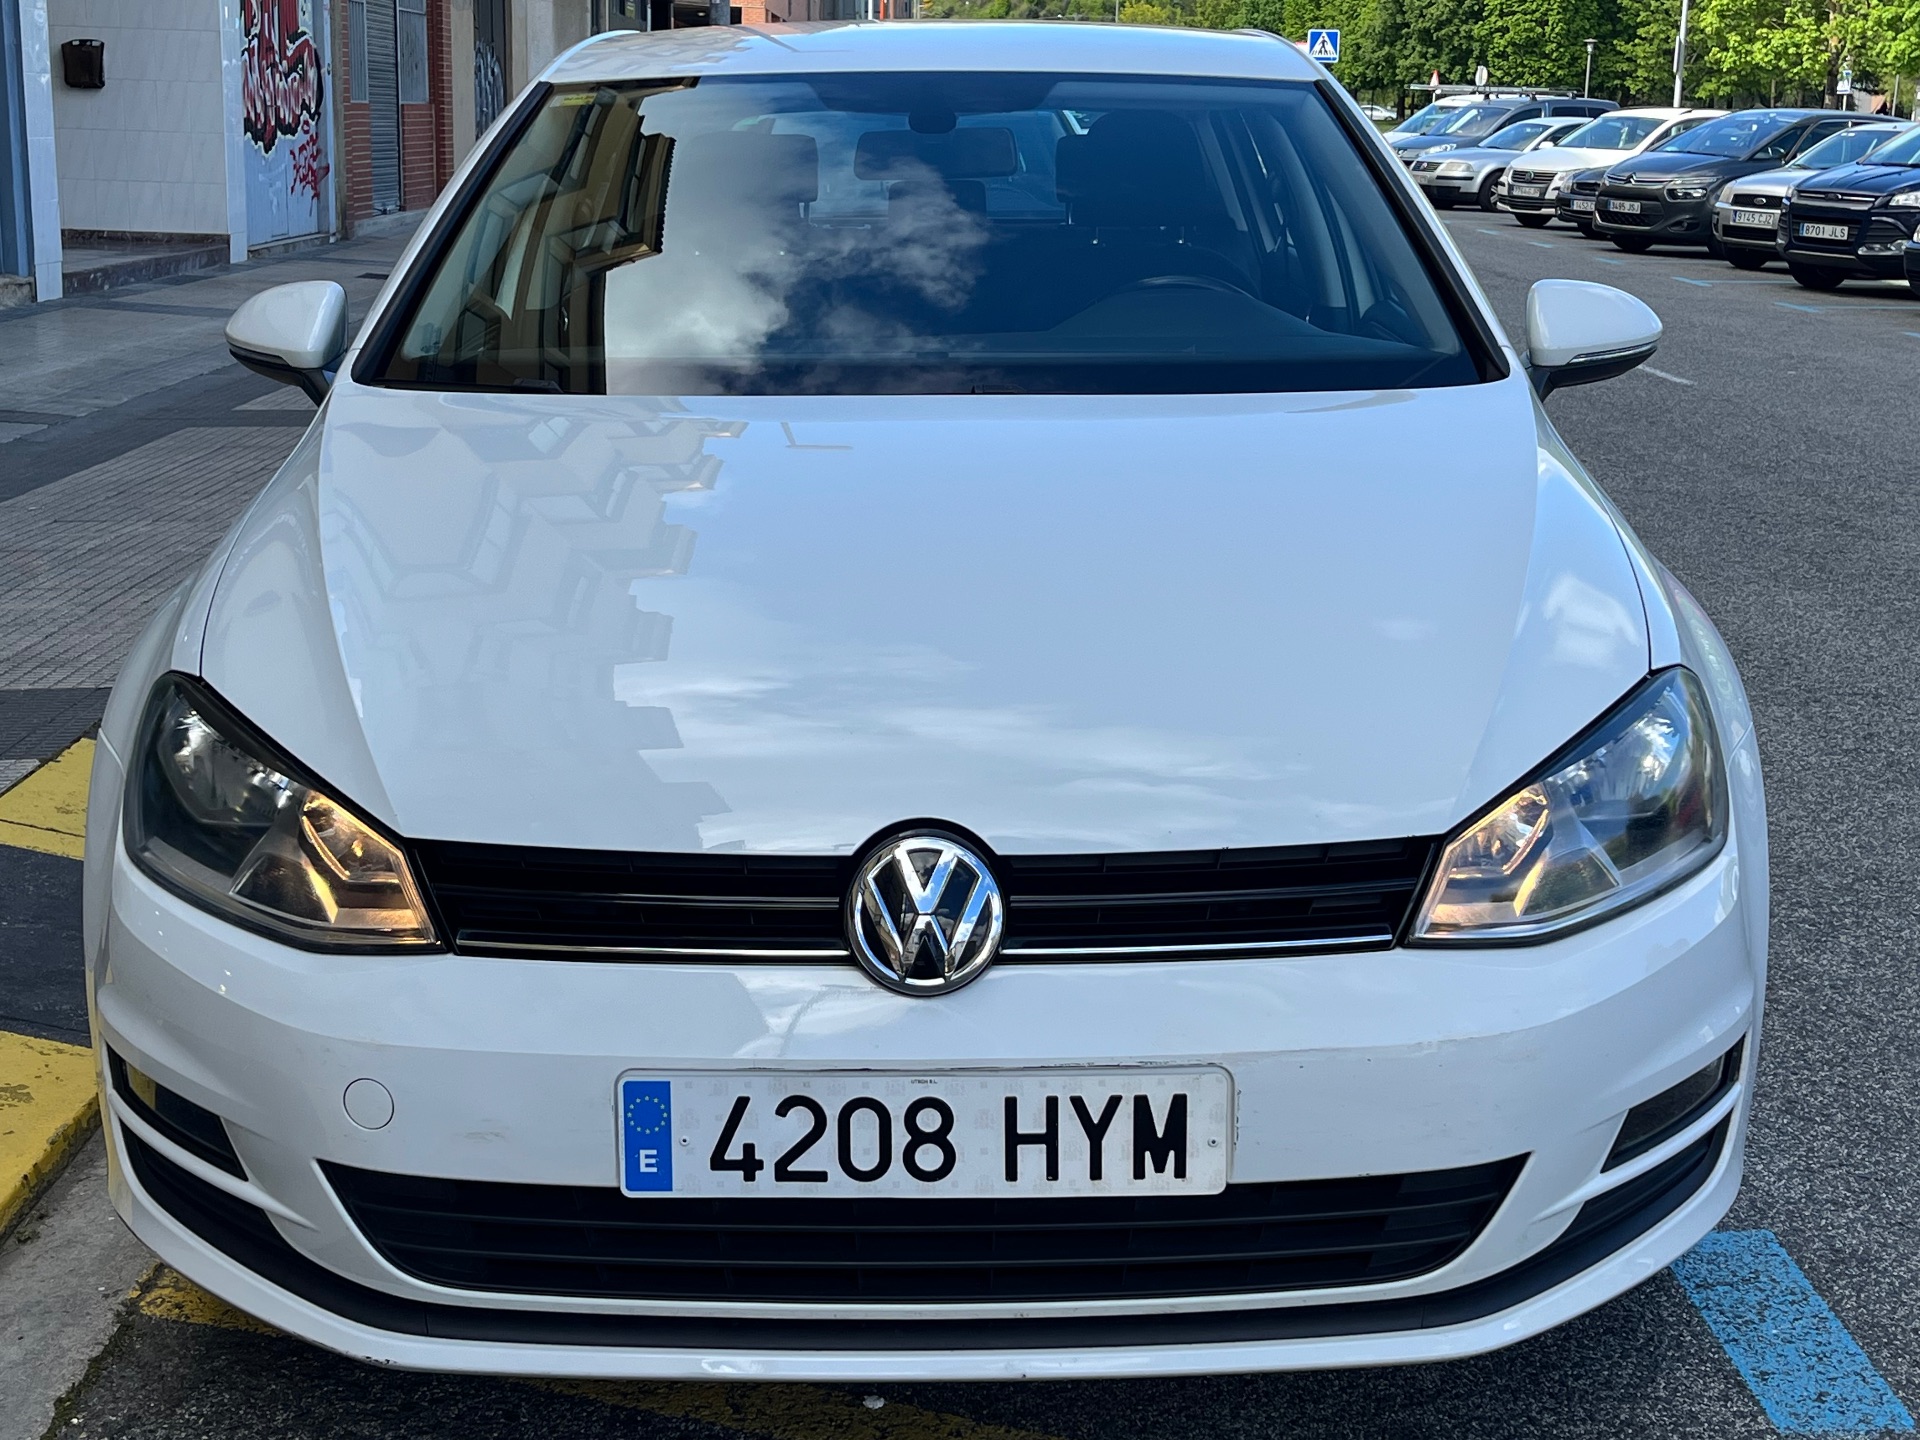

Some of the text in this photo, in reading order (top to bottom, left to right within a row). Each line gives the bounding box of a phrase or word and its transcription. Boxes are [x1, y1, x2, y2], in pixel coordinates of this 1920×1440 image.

[1737, 212, 1756, 223] 9145
[1805, 224, 1846, 238] 8701 JLS
[709, 1093, 1188, 1182] 4208 HYM
[640, 1149, 657, 1173] E
